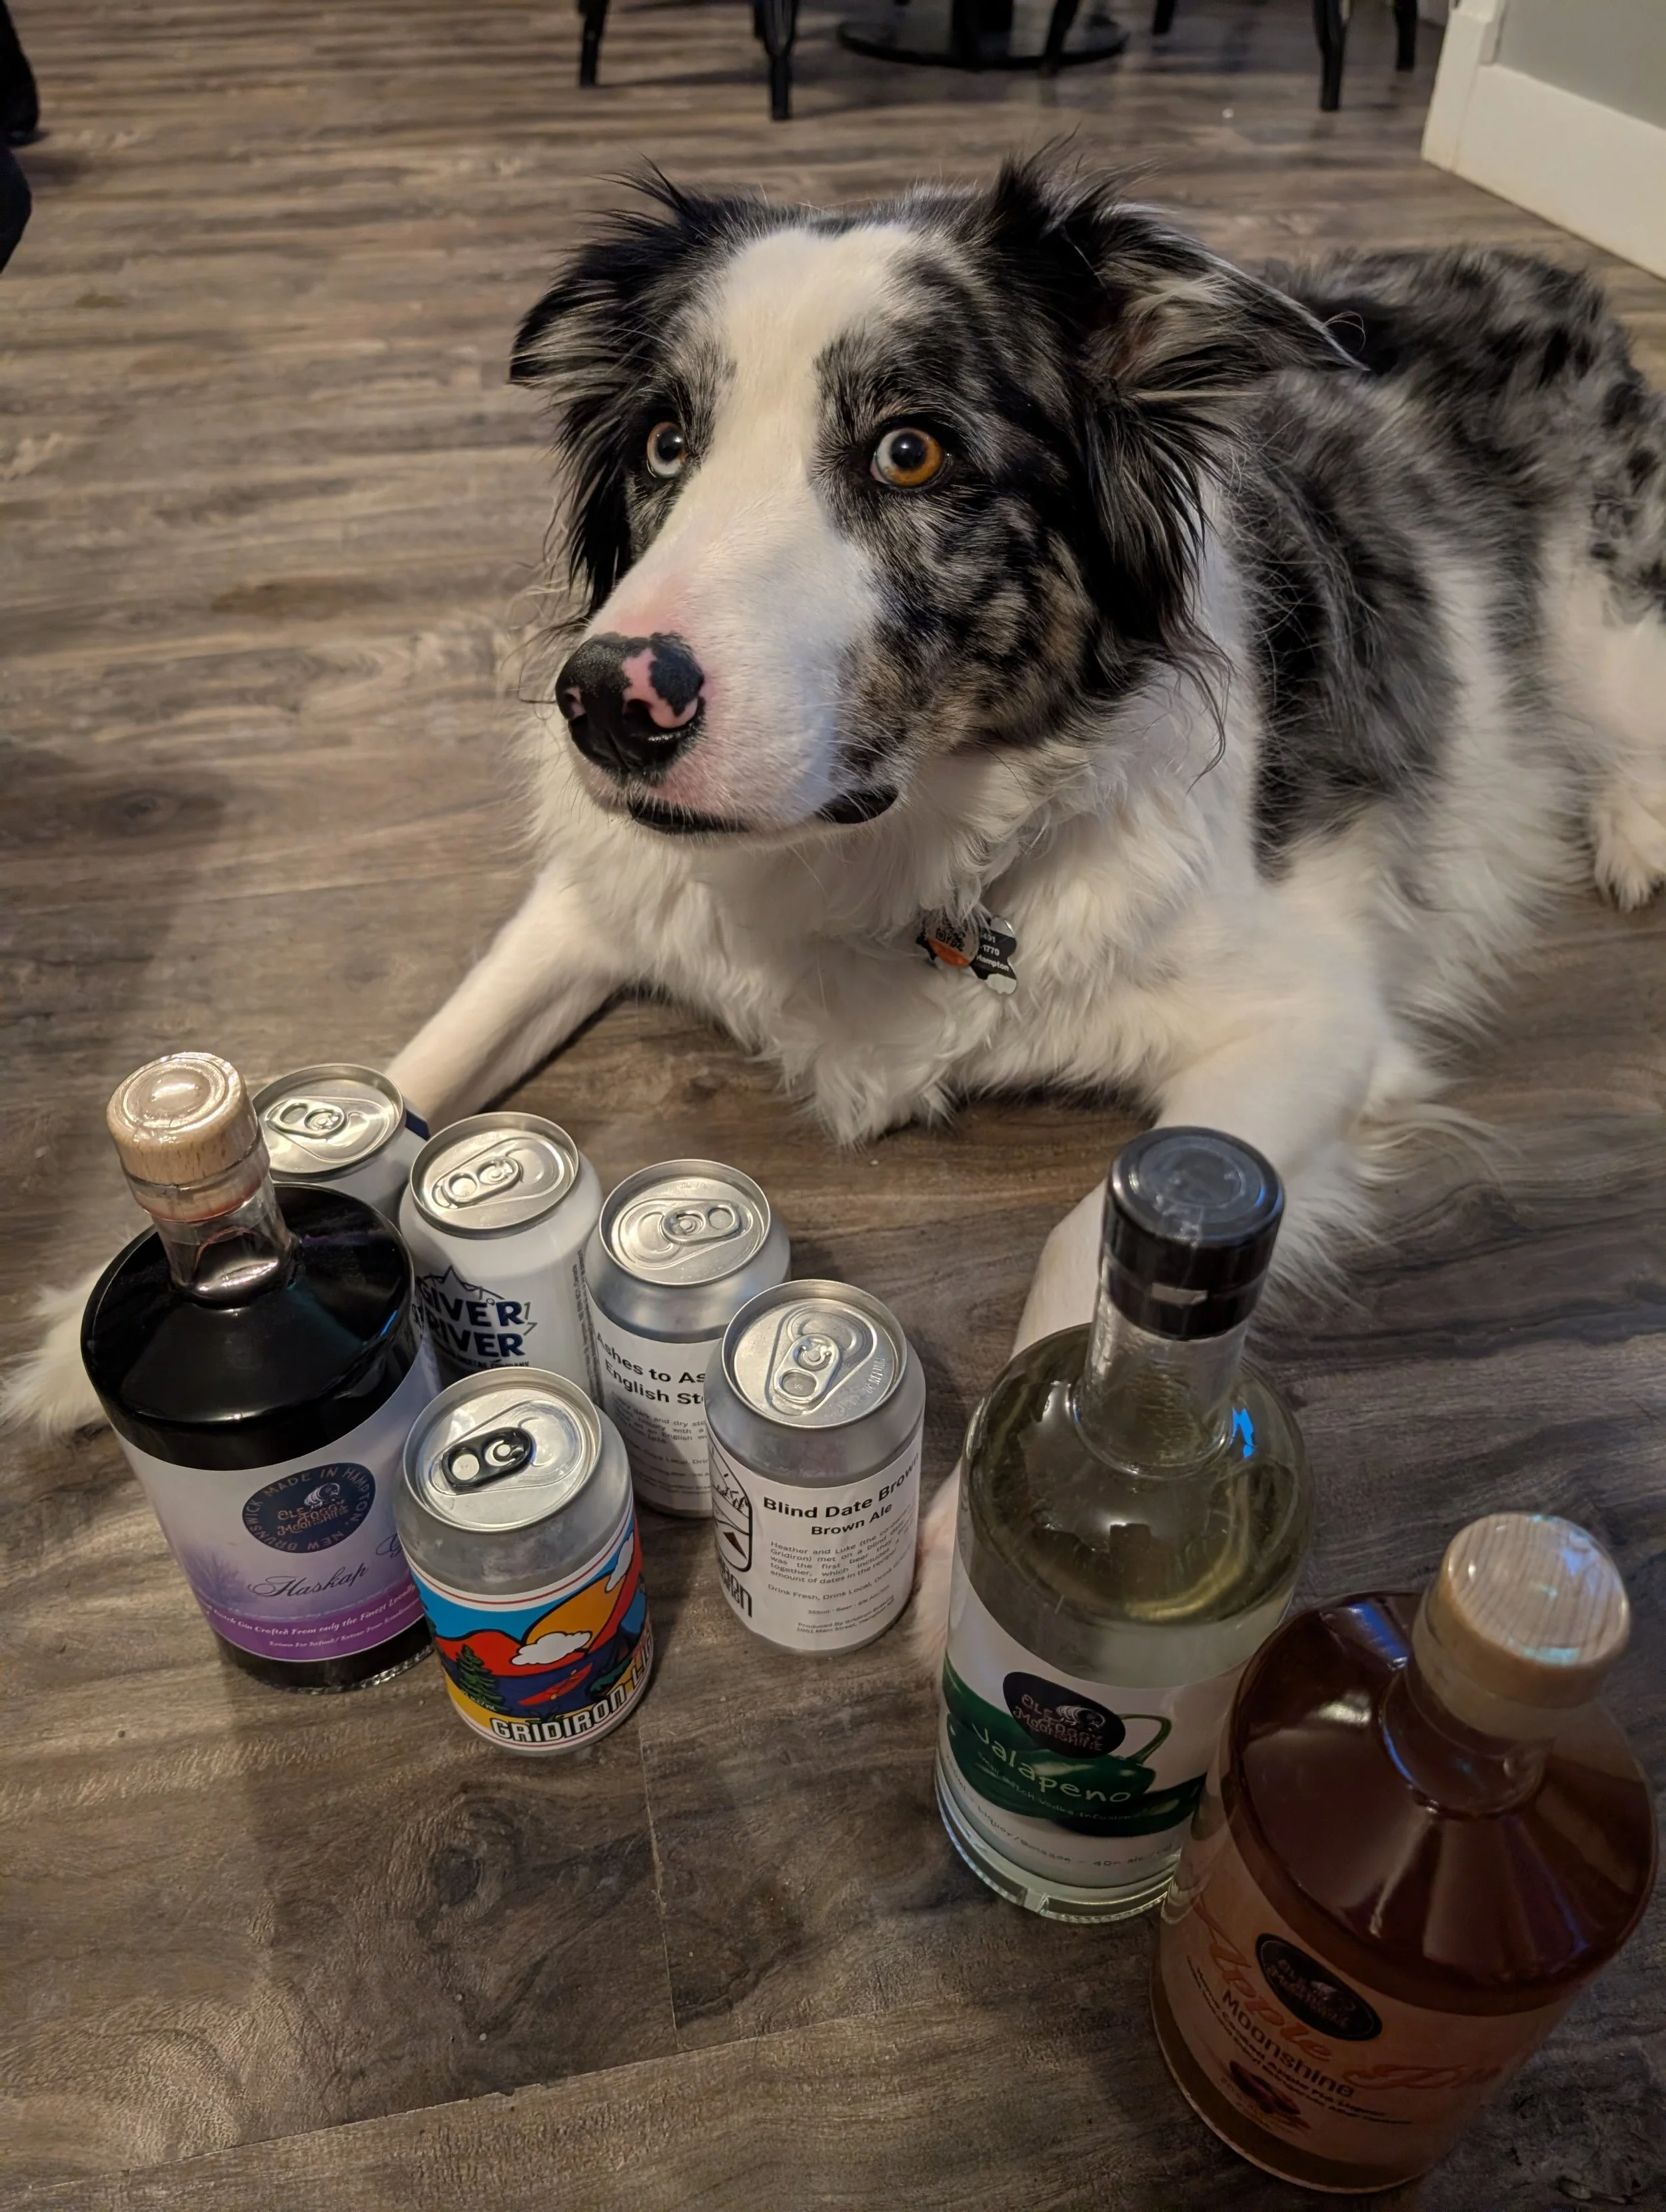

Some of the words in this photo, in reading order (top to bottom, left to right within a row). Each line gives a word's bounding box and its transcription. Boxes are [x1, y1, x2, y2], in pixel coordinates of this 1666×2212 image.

[605, 1359, 670, 1403] English
[648, 1368, 672, 1382] to
[662, 1430, 693, 1440] English
[673, 1419, 688, 1428] dry
[264, 1472, 311, 1497] MADE
[319, 1467, 339, 1478] IN
[763, 1496, 818, 1518] Blind
[825, 1497, 873, 1518] Date
[878, 1452, 920, 1501] Brown
[245, 1499, 299, 1552] BRUNSWICK
[810, 1518, 866, 1536] Brown
[868, 1503, 893, 1524] Ale
[307, 1530, 345, 1551] NEW
[770, 1540, 808, 1554] Heather
[835, 1544, 856, 1554] Luke
[770, 1548, 812, 1562] Gridiron)
[867, 1536, 887, 1550] blind
[770, 1556, 788, 1565] was
[849, 1553, 869, 1564] beer
[770, 1562, 813, 1576] together,
[821, 1567, 849, 1577] which
[247, 1562, 369, 1598] Haskap
[770, 1570, 806, 1583] amount
[857, 1566, 872, 1576] the
[768, 1583, 791, 1596] Drink
[793, 1591, 821, 1600] Fresh,
[822, 1591, 847, 1600] Drink
[254, 1624, 290, 1636] Crafted
[291, 1627, 317, 1636] From
[319, 1622, 341, 1634] only
[341, 1617, 358, 1627] the
[359, 1604, 388, 1622] Finest
[490, 1684, 628, 1743] GRIDIRON
[972, 1722, 1132, 1803] Jalapeno
[1222, 1989, 1354, 2098] Moonshine
